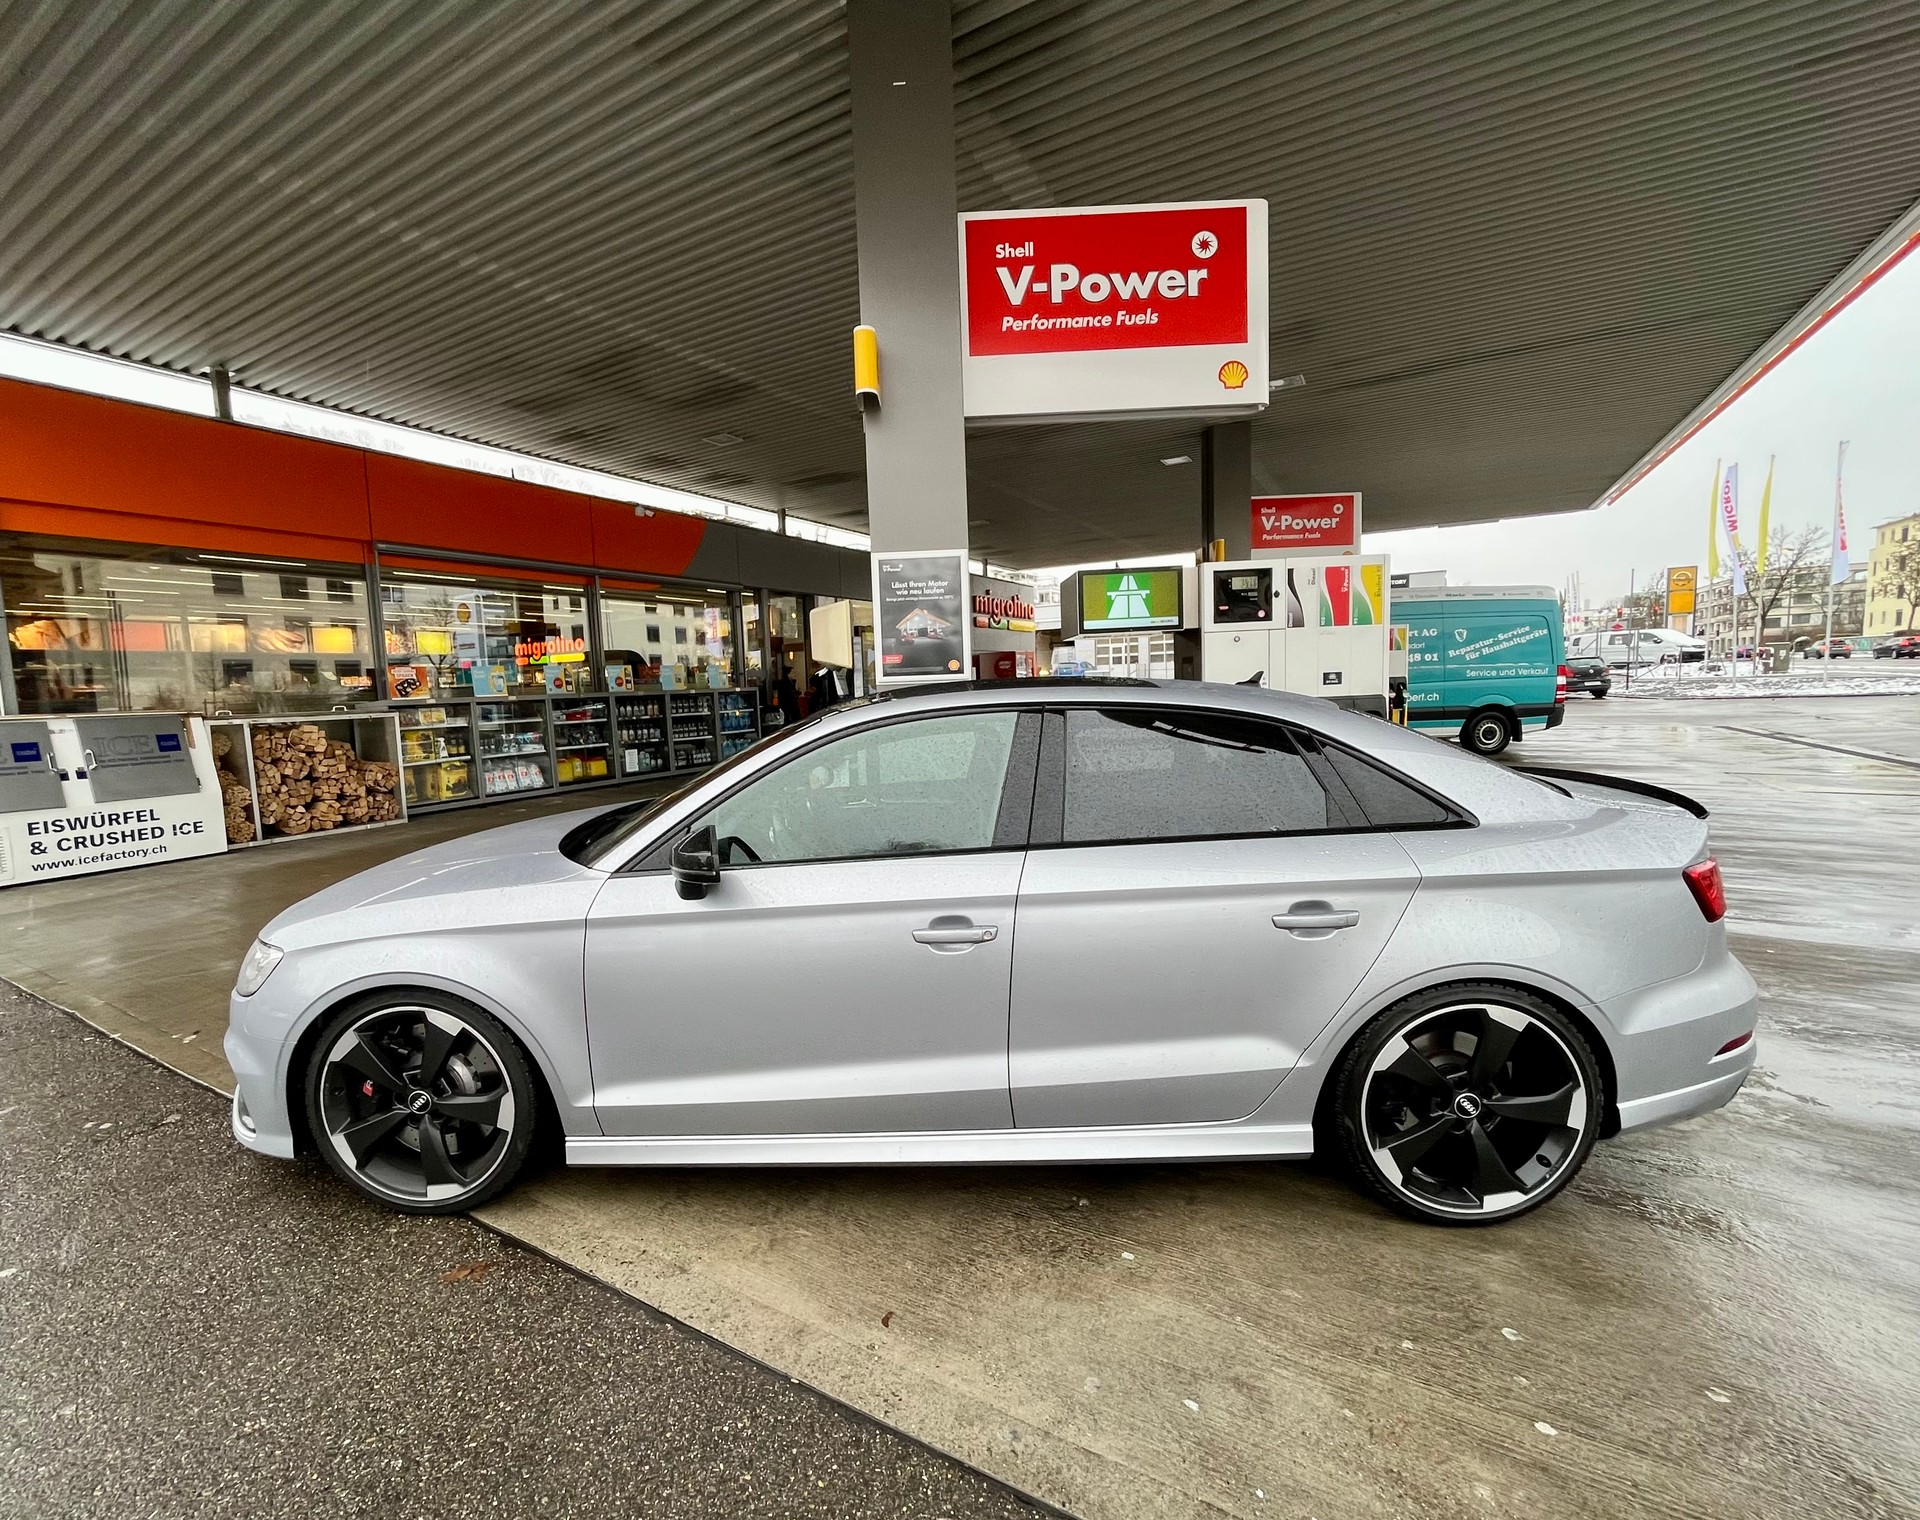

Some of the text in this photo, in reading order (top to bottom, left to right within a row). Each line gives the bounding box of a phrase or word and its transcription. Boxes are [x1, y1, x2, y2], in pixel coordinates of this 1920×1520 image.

[995, 241, 1034, 259] Shell
[995, 263, 1208, 306] V-Power
[1001, 308, 1159, 332] Performance Fuels
[1261, 515, 1340, 531] V-Power
[1262, 533, 1304, 541] Performance
[891, 581, 908, 589] Lässt
[909, 580, 927, 588] Ihren
[896, 588, 909, 596] wie
[974, 589, 1035, 625] migrolino
[1421, 628, 1438, 637] AG
[1447, 626, 1531, 658] Reparatur-Service
[1465, 628, 1549, 661] für Haushaltgeräte
[514, 634, 585, 660] migrolino
[1466, 667, 1549, 678] Service und Verkauf
[27, 809, 160, 836] EISWÜRFEL
[30, 821, 205, 855] & CRUSHED ICE
[31, 844, 167, 872] www.icefactory.ch
